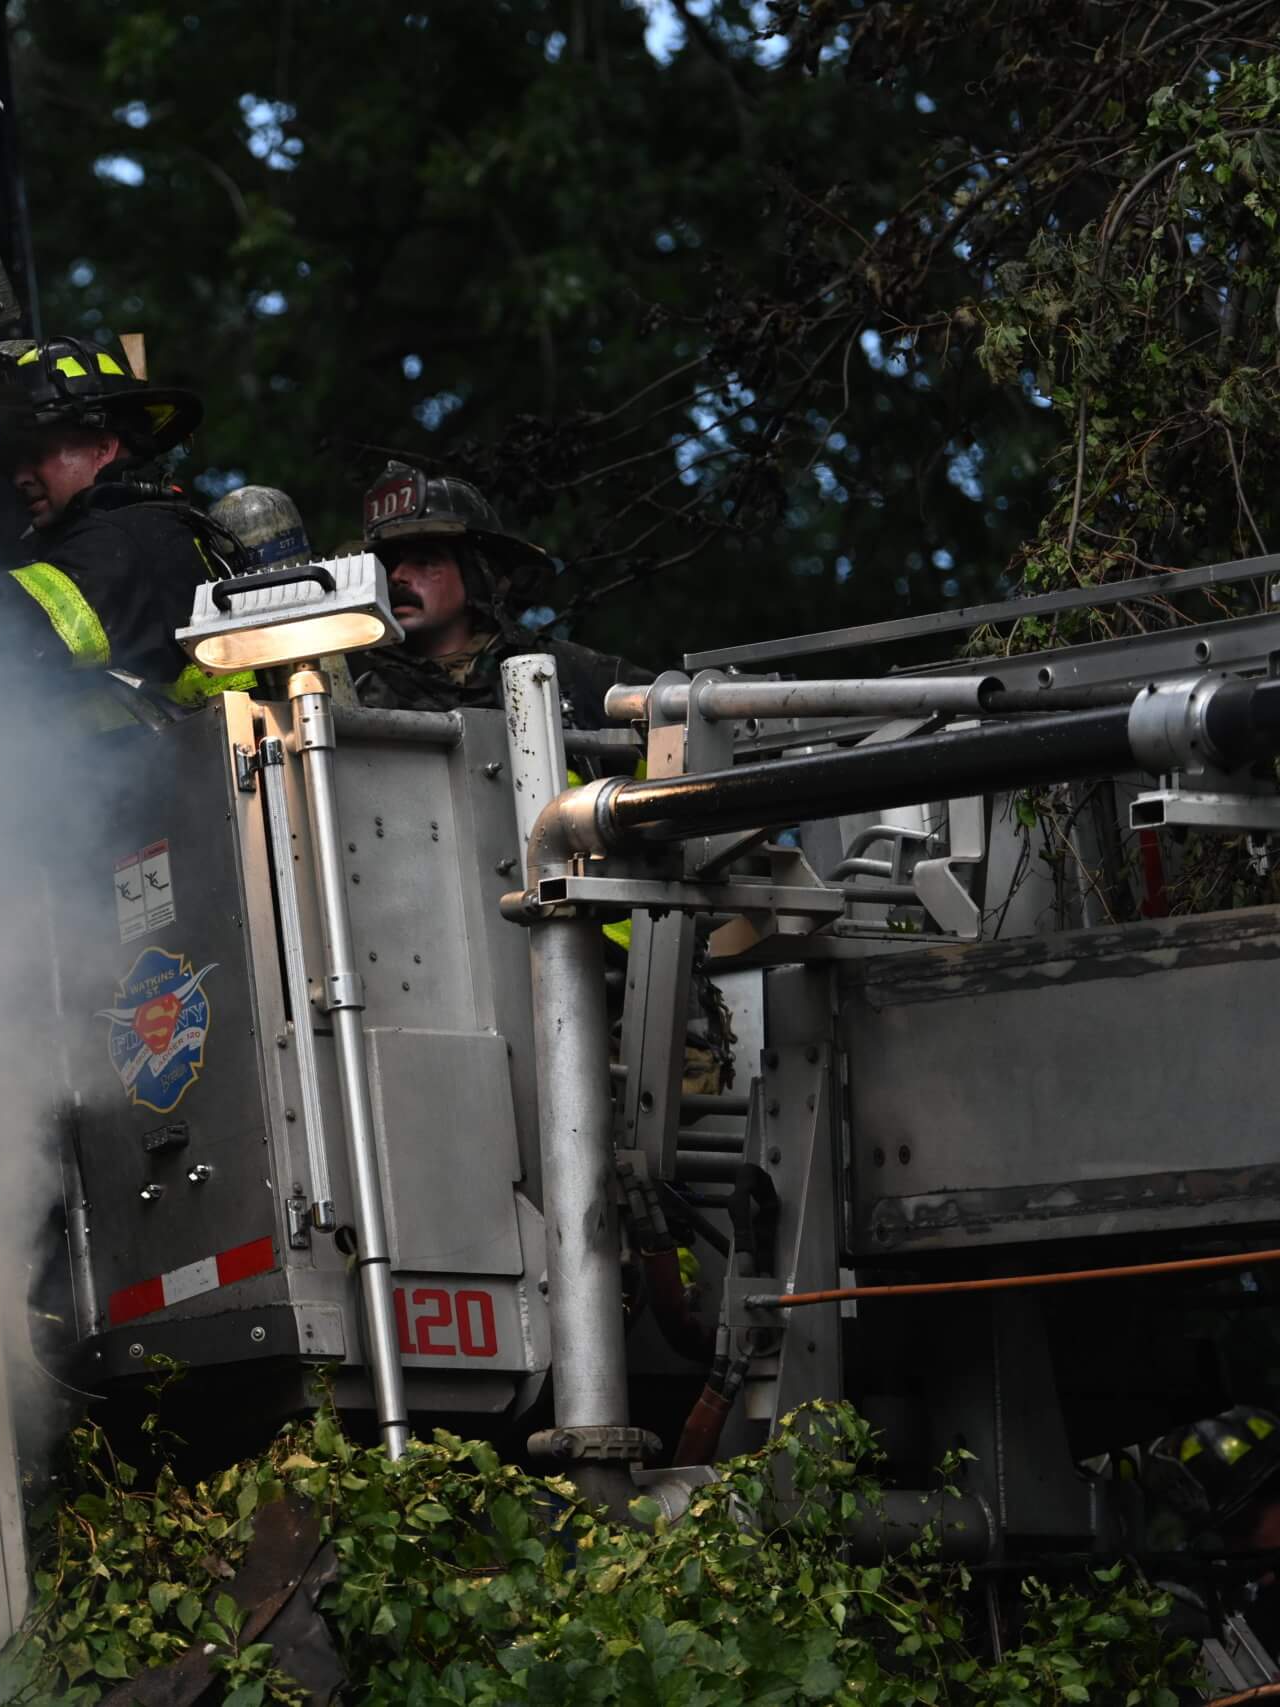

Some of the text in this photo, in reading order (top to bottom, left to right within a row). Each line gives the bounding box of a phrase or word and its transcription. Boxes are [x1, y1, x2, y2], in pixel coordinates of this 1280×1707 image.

[370, 486, 412, 521] 107
[130, 968, 175, 995] WATKINS
[186, 1030, 201, 1040] 120
[393, 1287, 498, 1357] 120
